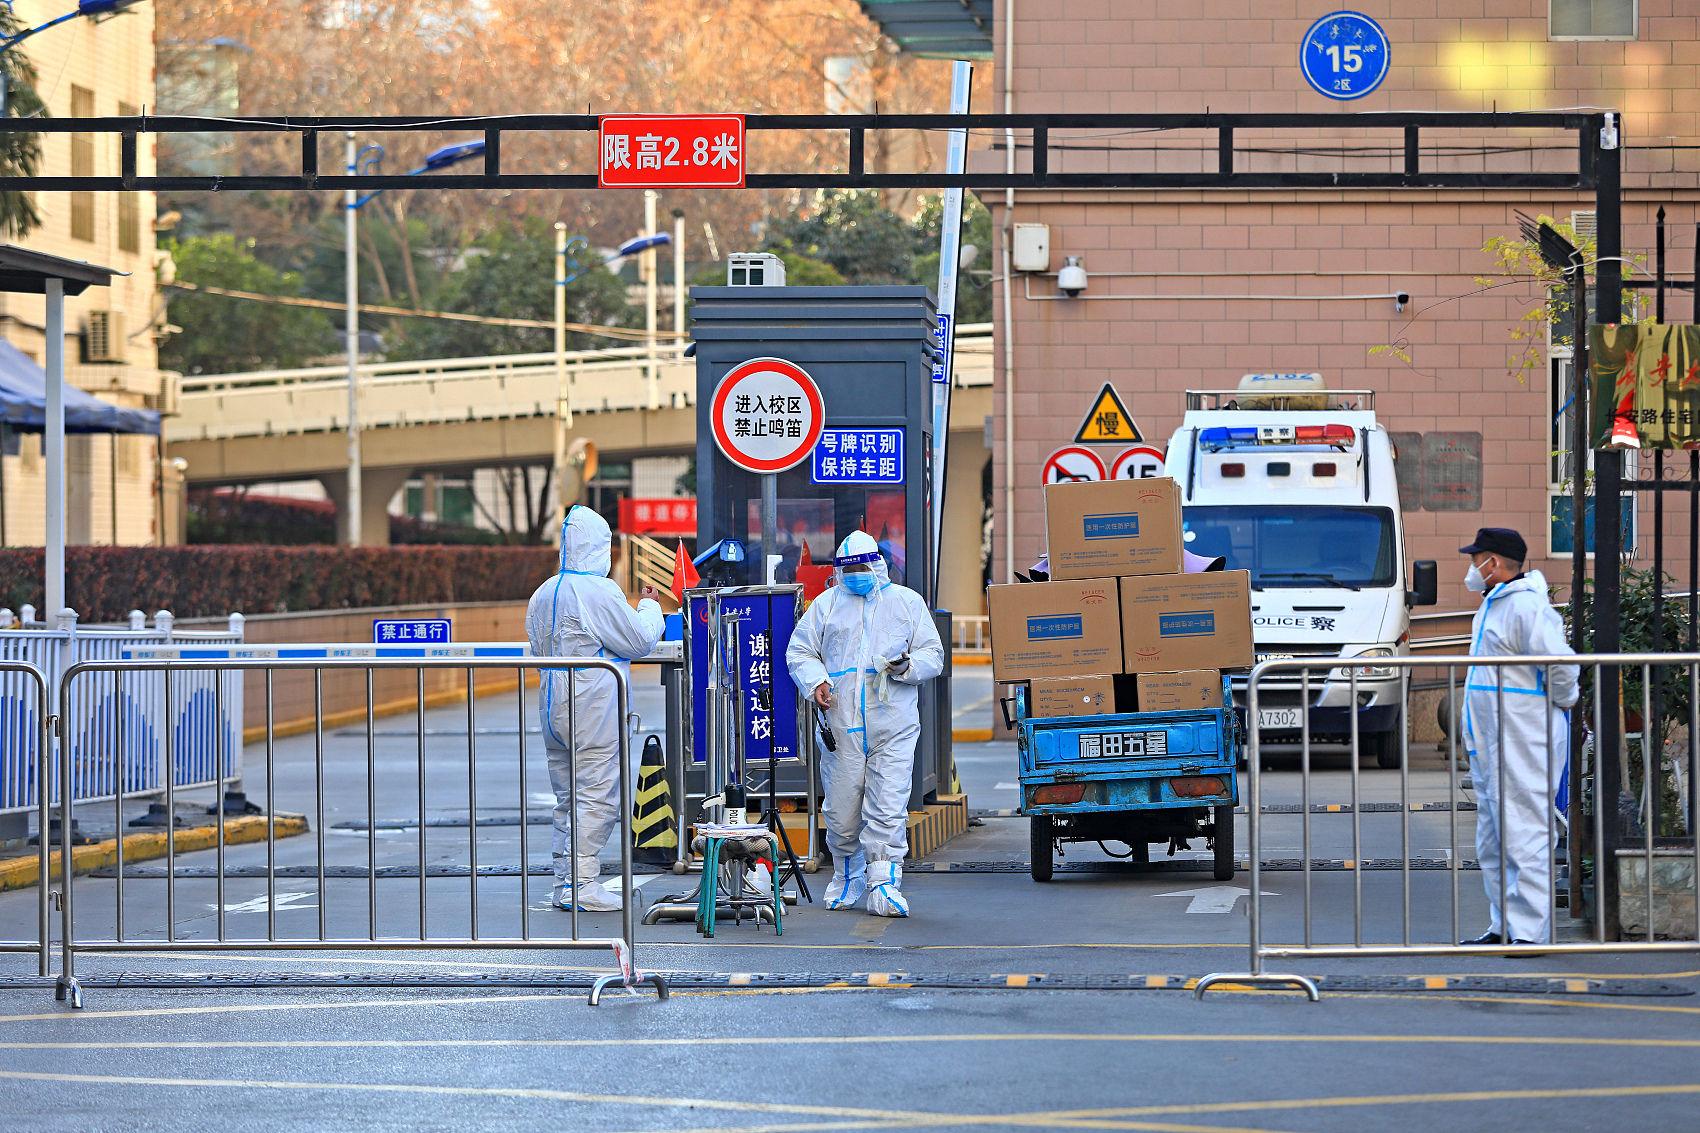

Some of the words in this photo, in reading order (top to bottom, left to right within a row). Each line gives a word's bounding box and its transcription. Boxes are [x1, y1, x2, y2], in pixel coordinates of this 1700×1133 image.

[1326, 45, 1363, 73] 15
[1334, 79, 1351, 91] 2区
[604, 133, 738, 170] 限高2.8米
[735, 395, 802, 414] 进入校区
[1096, 412, 1119, 436] 慢
[1606, 409, 1700, 424] 长安路住宅
[734, 418, 803, 437] 禁止鸣笛
[821, 433, 896, 453] 号牌识别
[821, 457, 896, 477] 保持车距
[382, 624, 443, 640] 禁止通行
[1258, 711, 1296, 726] A7302
[1080, 731, 1167, 758] 福田五星
